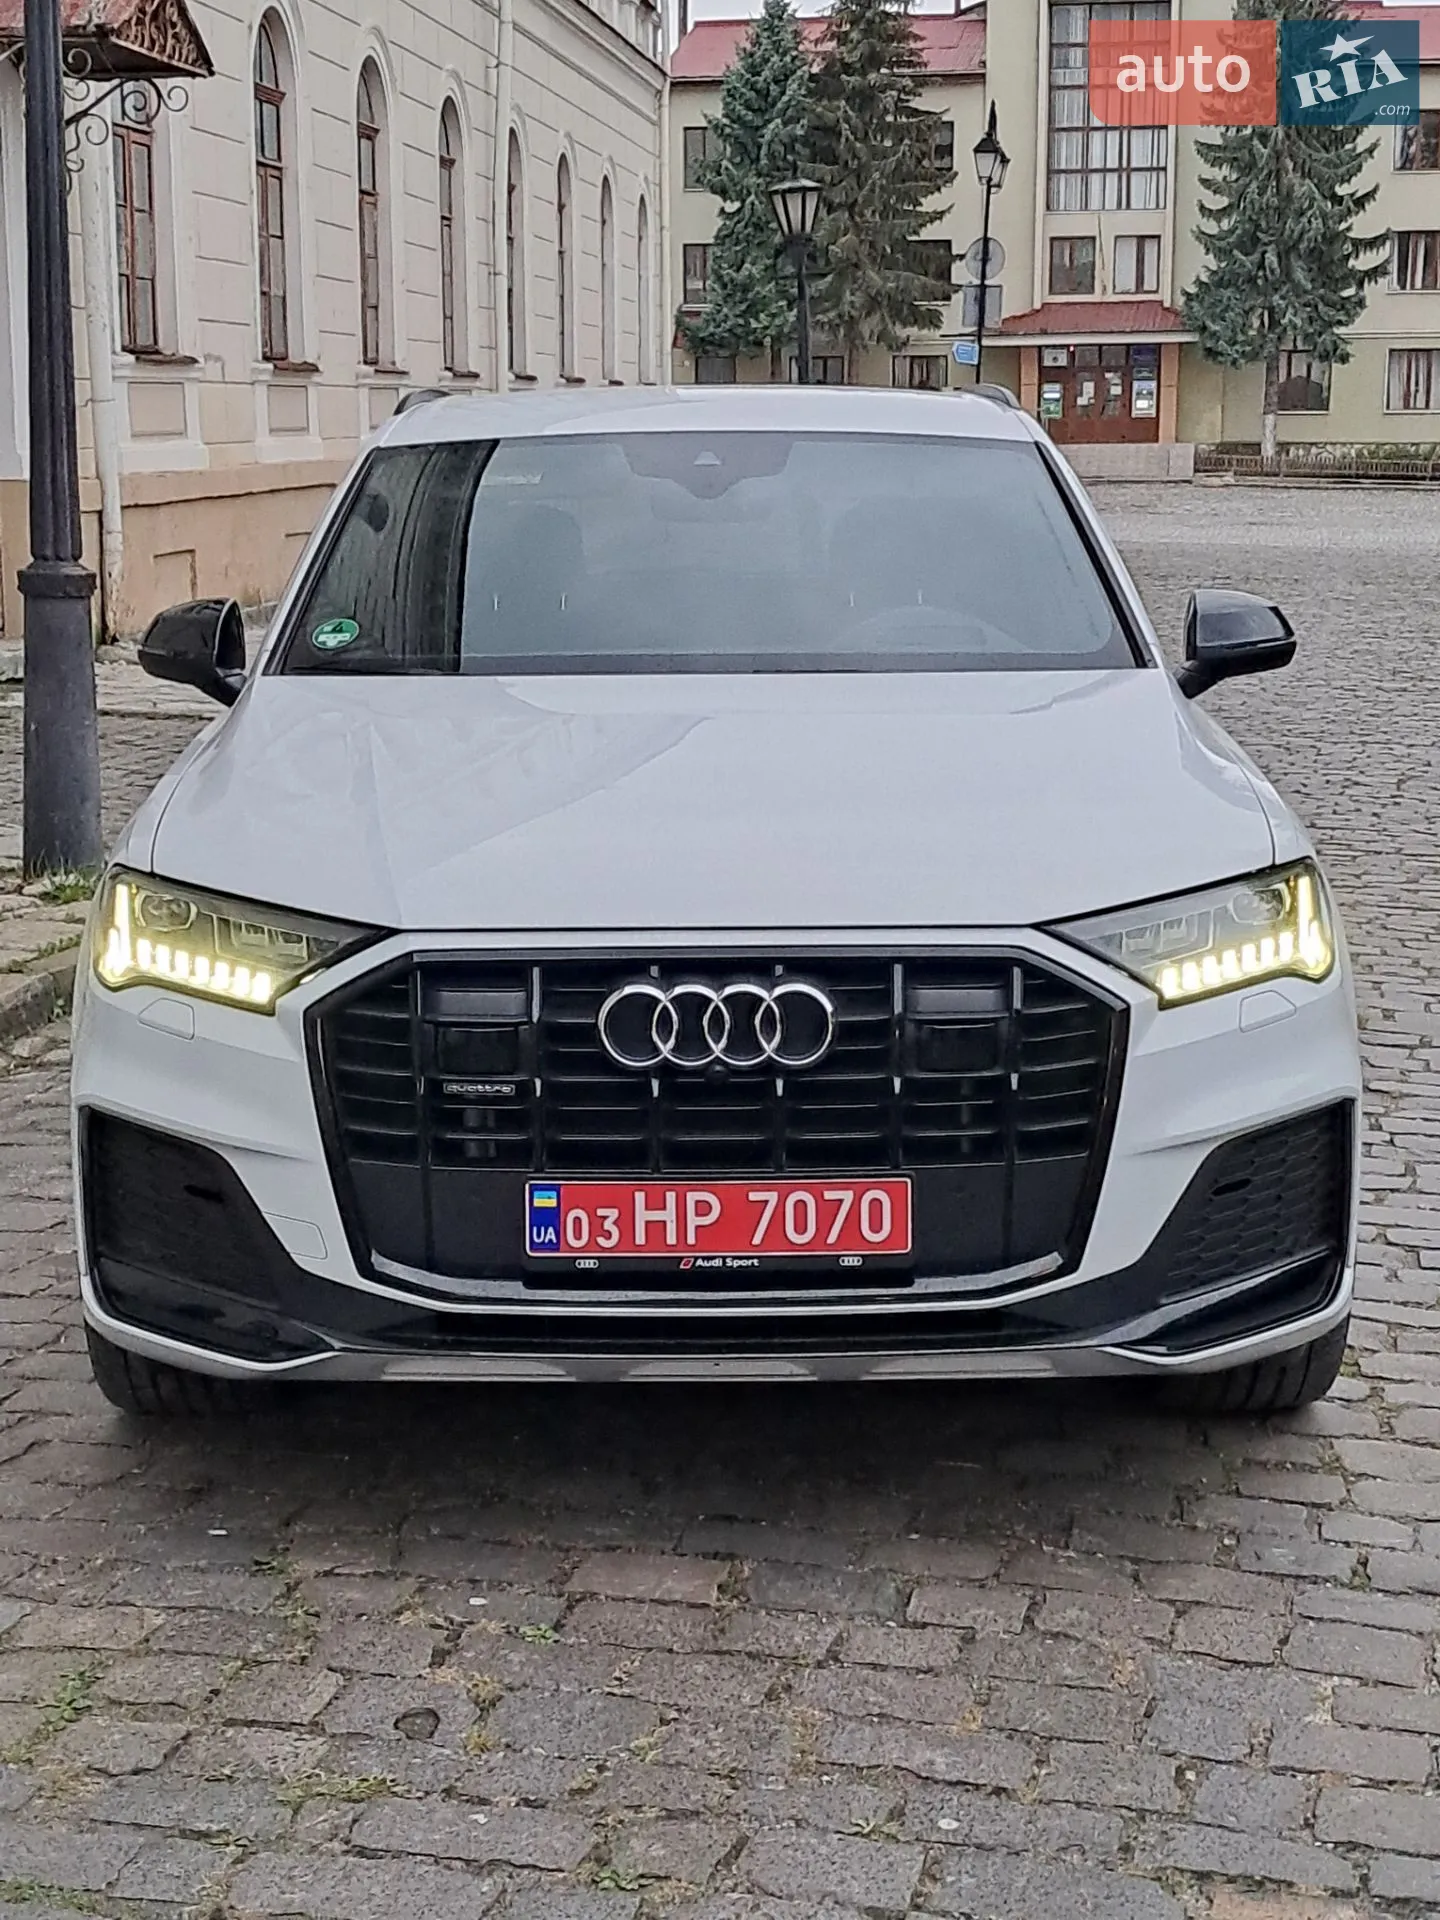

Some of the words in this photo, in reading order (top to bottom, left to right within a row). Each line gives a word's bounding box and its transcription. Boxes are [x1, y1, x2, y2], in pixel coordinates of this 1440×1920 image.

[445, 1084, 512, 1094] quattro
[565, 1208, 620, 1248] 03
[633, 1190, 721, 1246] HP
[748, 1189, 892, 1245] 7070
[532, 1226, 557, 1244] UA
[695, 1257, 723, 1267] Audi
[725, 1257, 760, 1268] Sport
